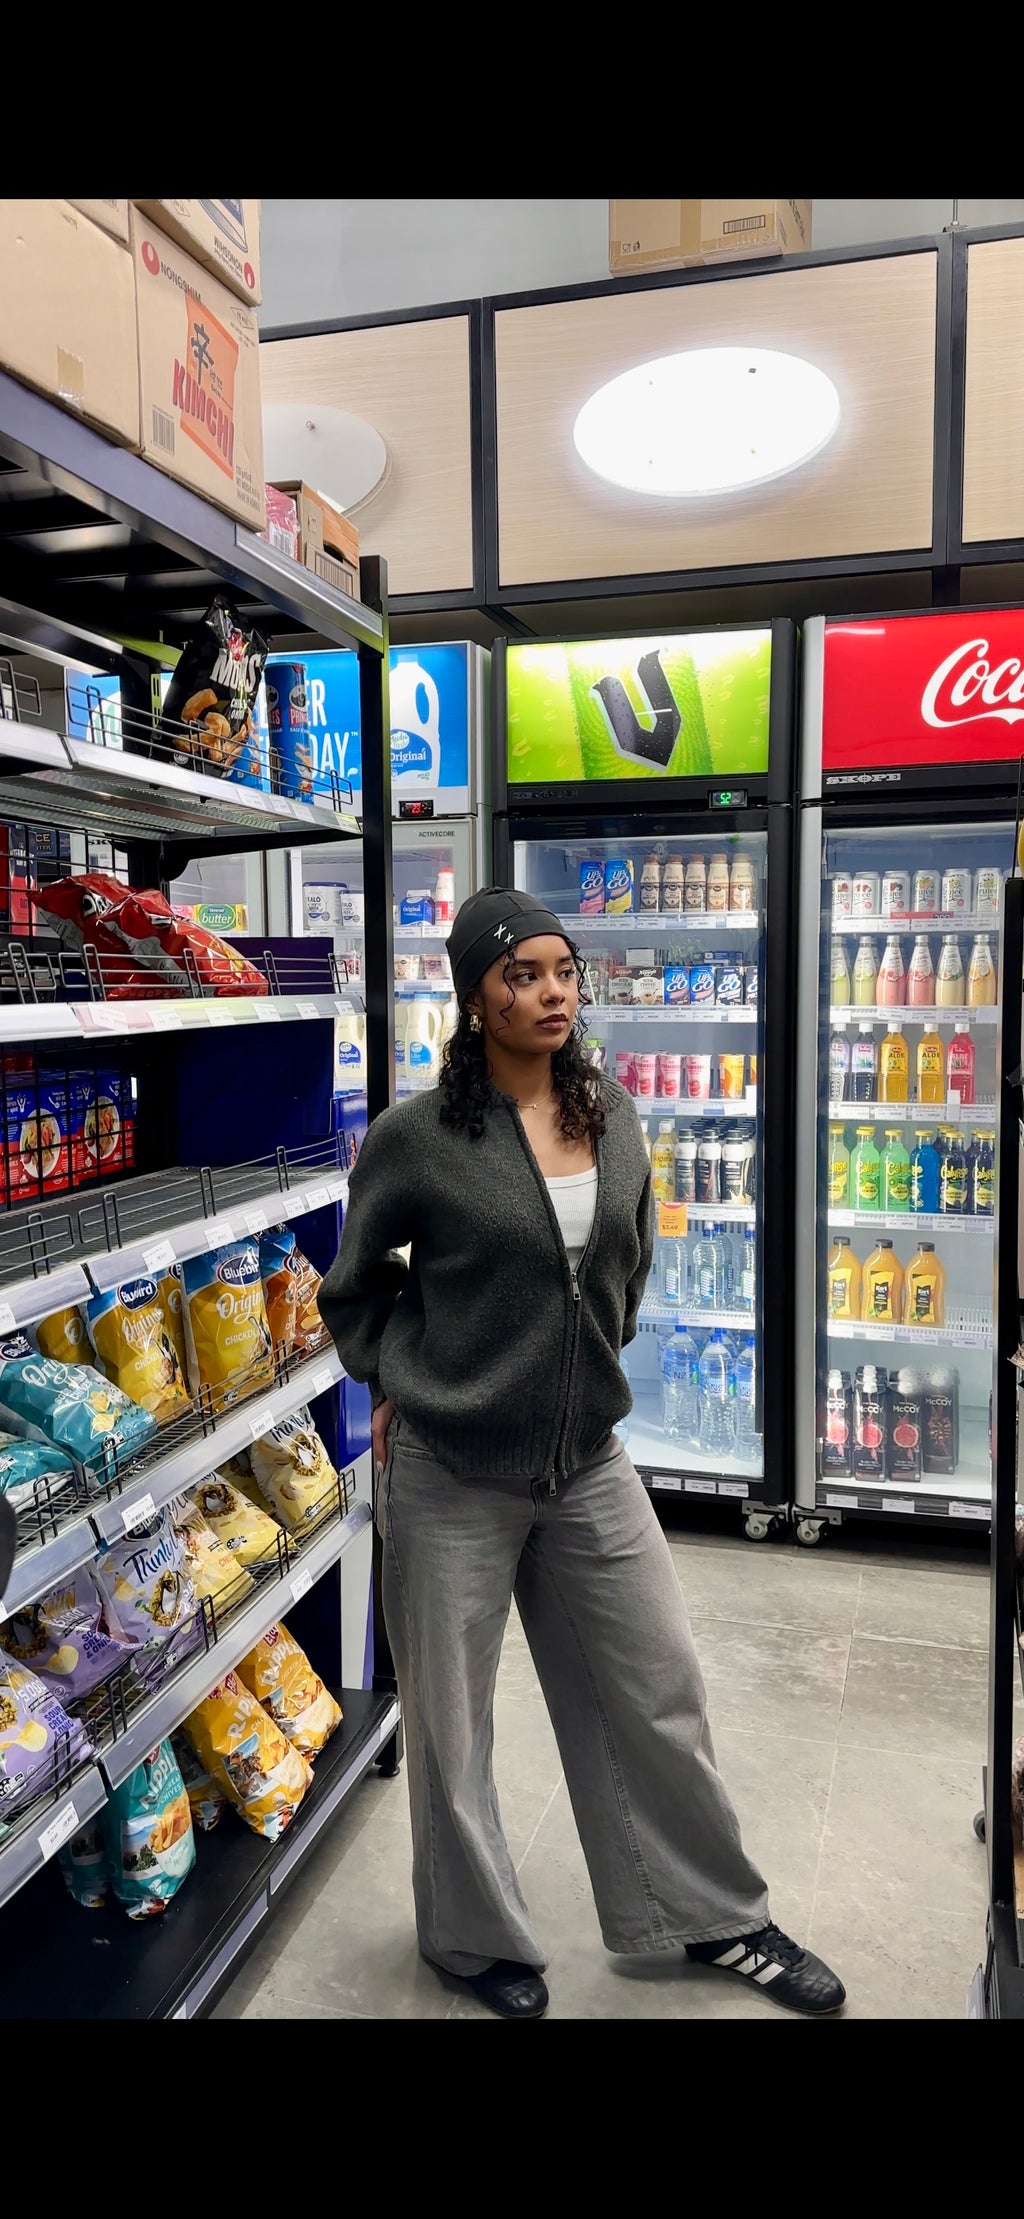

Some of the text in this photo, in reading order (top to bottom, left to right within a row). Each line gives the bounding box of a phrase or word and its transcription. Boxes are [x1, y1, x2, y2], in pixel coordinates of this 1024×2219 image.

[161, 260, 202, 304] NONGSHIM
[172, 357, 234, 468] KIMCHI
[591, 649, 683, 772] V
[391, 747, 427, 763] Original
[826, 772, 902, 785] SKOPE
[418, 830, 455, 838] ACTIVECORE
[581, 877, 604, 890] GO
[607, 876, 630, 890] GO
[202, 912, 232, 924] butter
[666, 979, 688, 992] GO
[692, 979, 715, 992] GO
[717, 979, 741, 993] GO
[223, 1263, 259, 1280] Bluebir
[225, 1328, 257, 1346] CHICKEN
[893, 1404, 920, 1414] McCOY
[83, 1636, 101, 1651] CRE
[93, 1637, 111, 1654] ONIO
[251, 1716, 265, 1731] CHI
